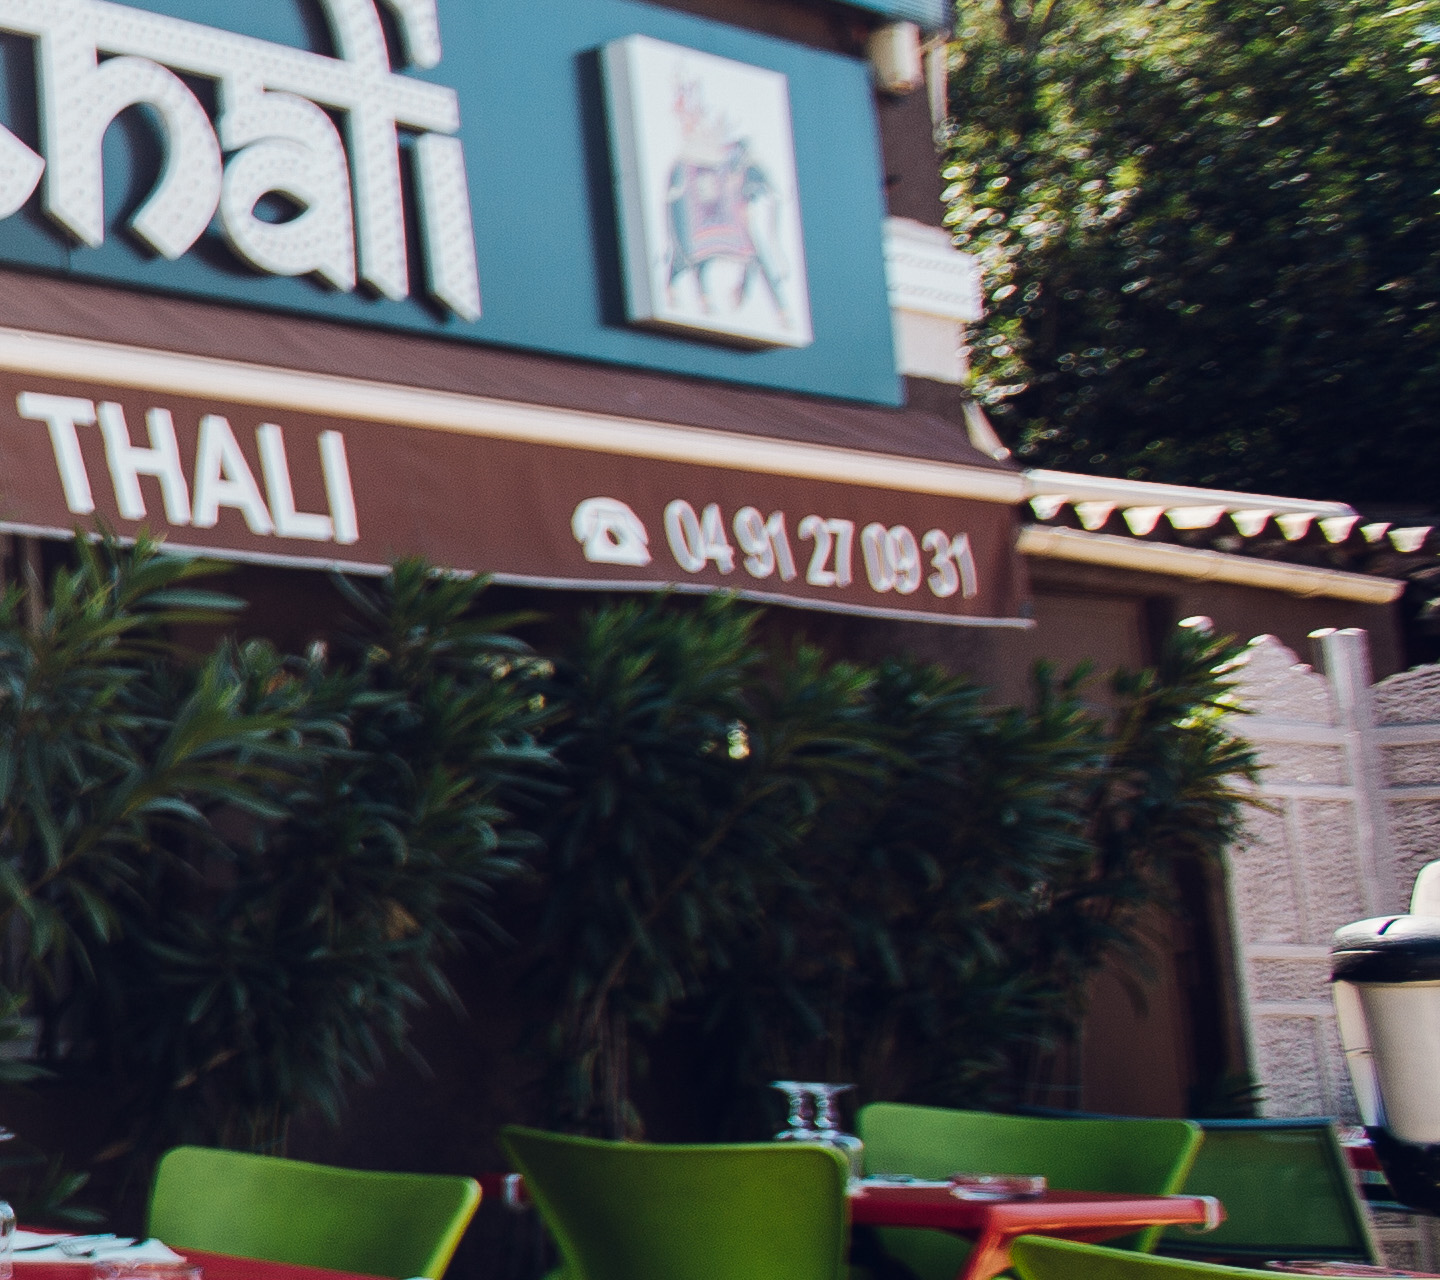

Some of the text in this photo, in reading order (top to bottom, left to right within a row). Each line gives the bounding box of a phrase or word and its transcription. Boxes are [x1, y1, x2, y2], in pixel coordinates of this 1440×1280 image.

[18, 389, 360, 545] THALI
[664, 499, 735, 575] 04
[733, 506, 797, 581] 91
[798, 514, 855, 588] 27
[860, 522, 921, 595] 09
[922, 529, 977, 599] 31
